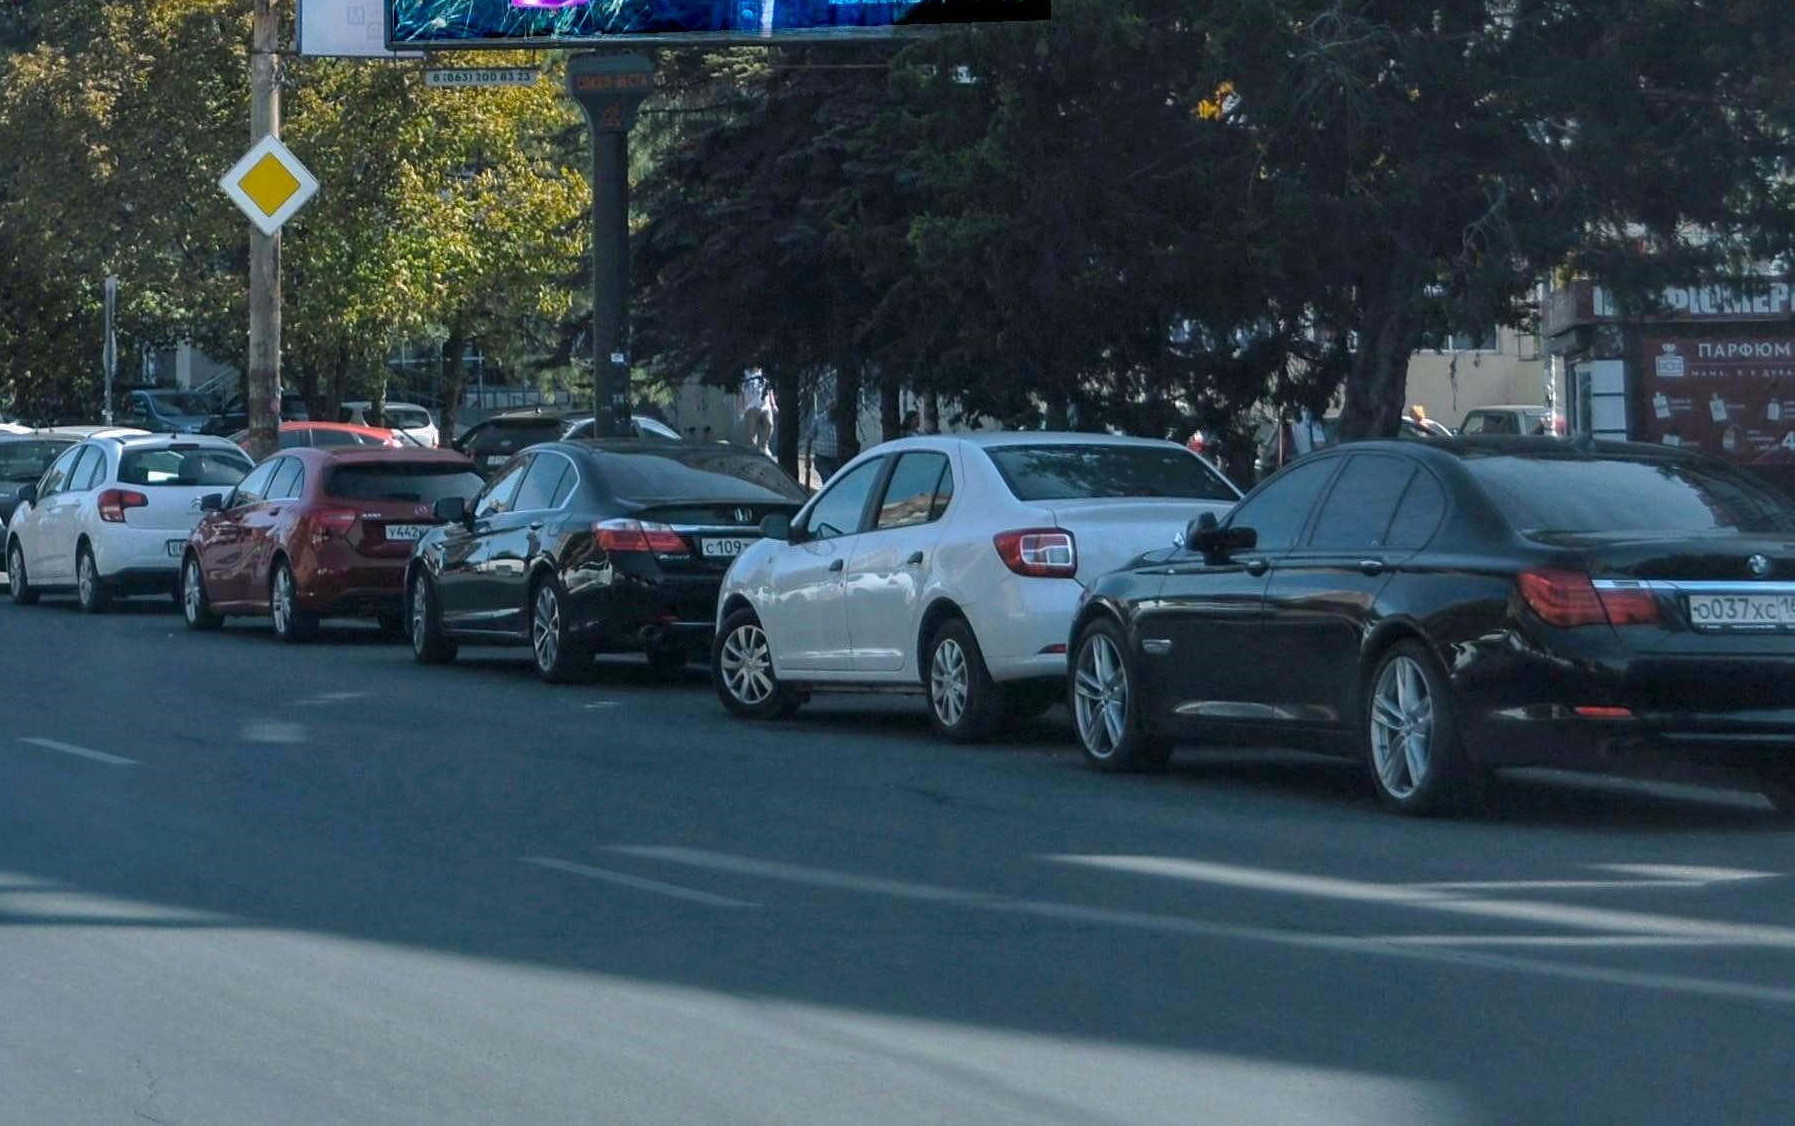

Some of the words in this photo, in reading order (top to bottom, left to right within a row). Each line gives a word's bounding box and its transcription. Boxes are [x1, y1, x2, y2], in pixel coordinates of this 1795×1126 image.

[443, 72, 473, 83] (863)
[476, 72, 498, 82] 200
[517, 72, 531, 81] 23
